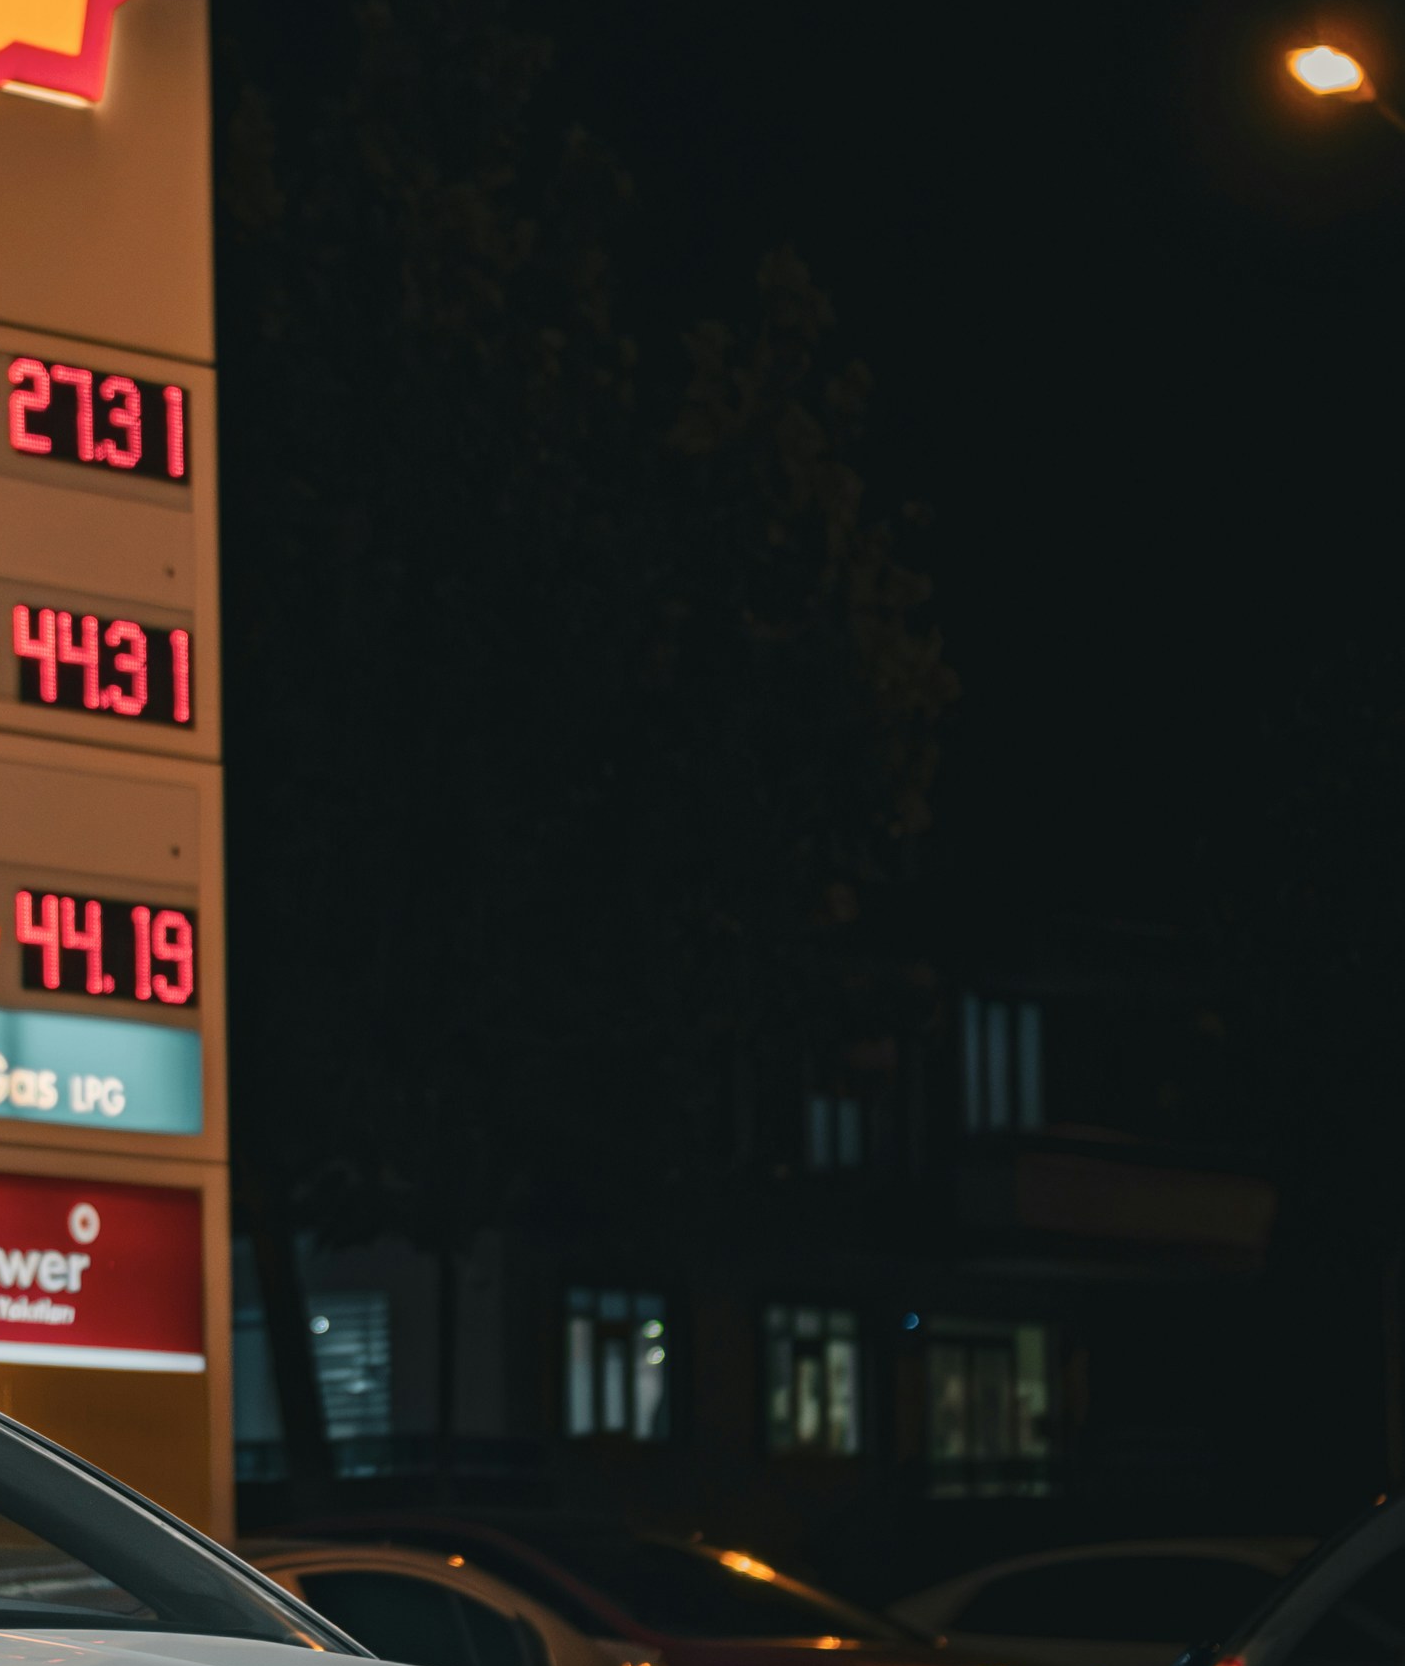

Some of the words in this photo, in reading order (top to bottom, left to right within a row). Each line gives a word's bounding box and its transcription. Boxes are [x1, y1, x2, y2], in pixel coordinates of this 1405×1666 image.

[8, 357, 184, 478] 27.31
[13, 605, 190, 723] 44.31
[15, 890, 193, 1005] 44.19
[70, 1074, 126, 1117] LPG
